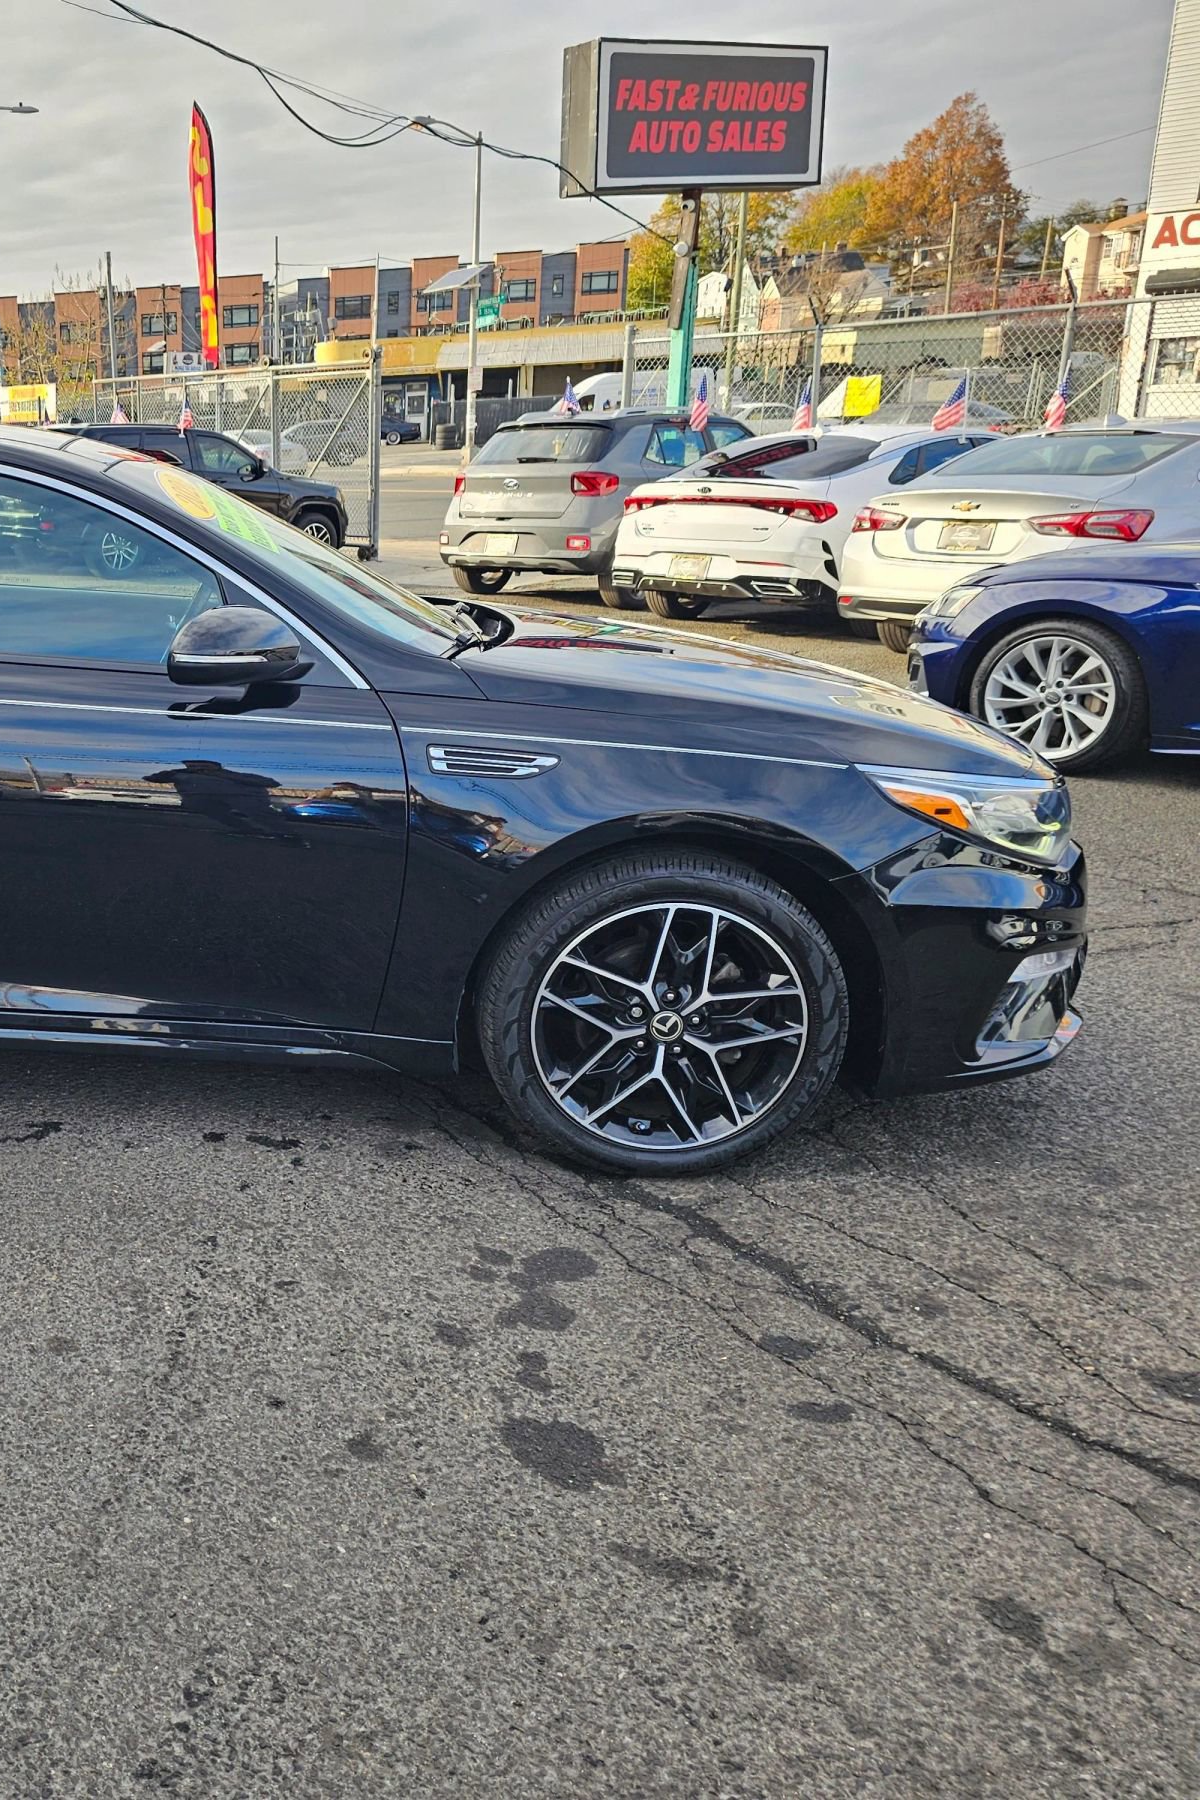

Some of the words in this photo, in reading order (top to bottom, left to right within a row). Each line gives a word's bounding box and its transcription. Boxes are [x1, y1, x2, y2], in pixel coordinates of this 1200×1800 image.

[615, 79, 681, 112] FAST
[678, 83, 700, 111] &
[702, 81, 808, 112] FURIOUS
[628, 120, 702, 153] AUTO
[706, 120, 788, 153] SALES
